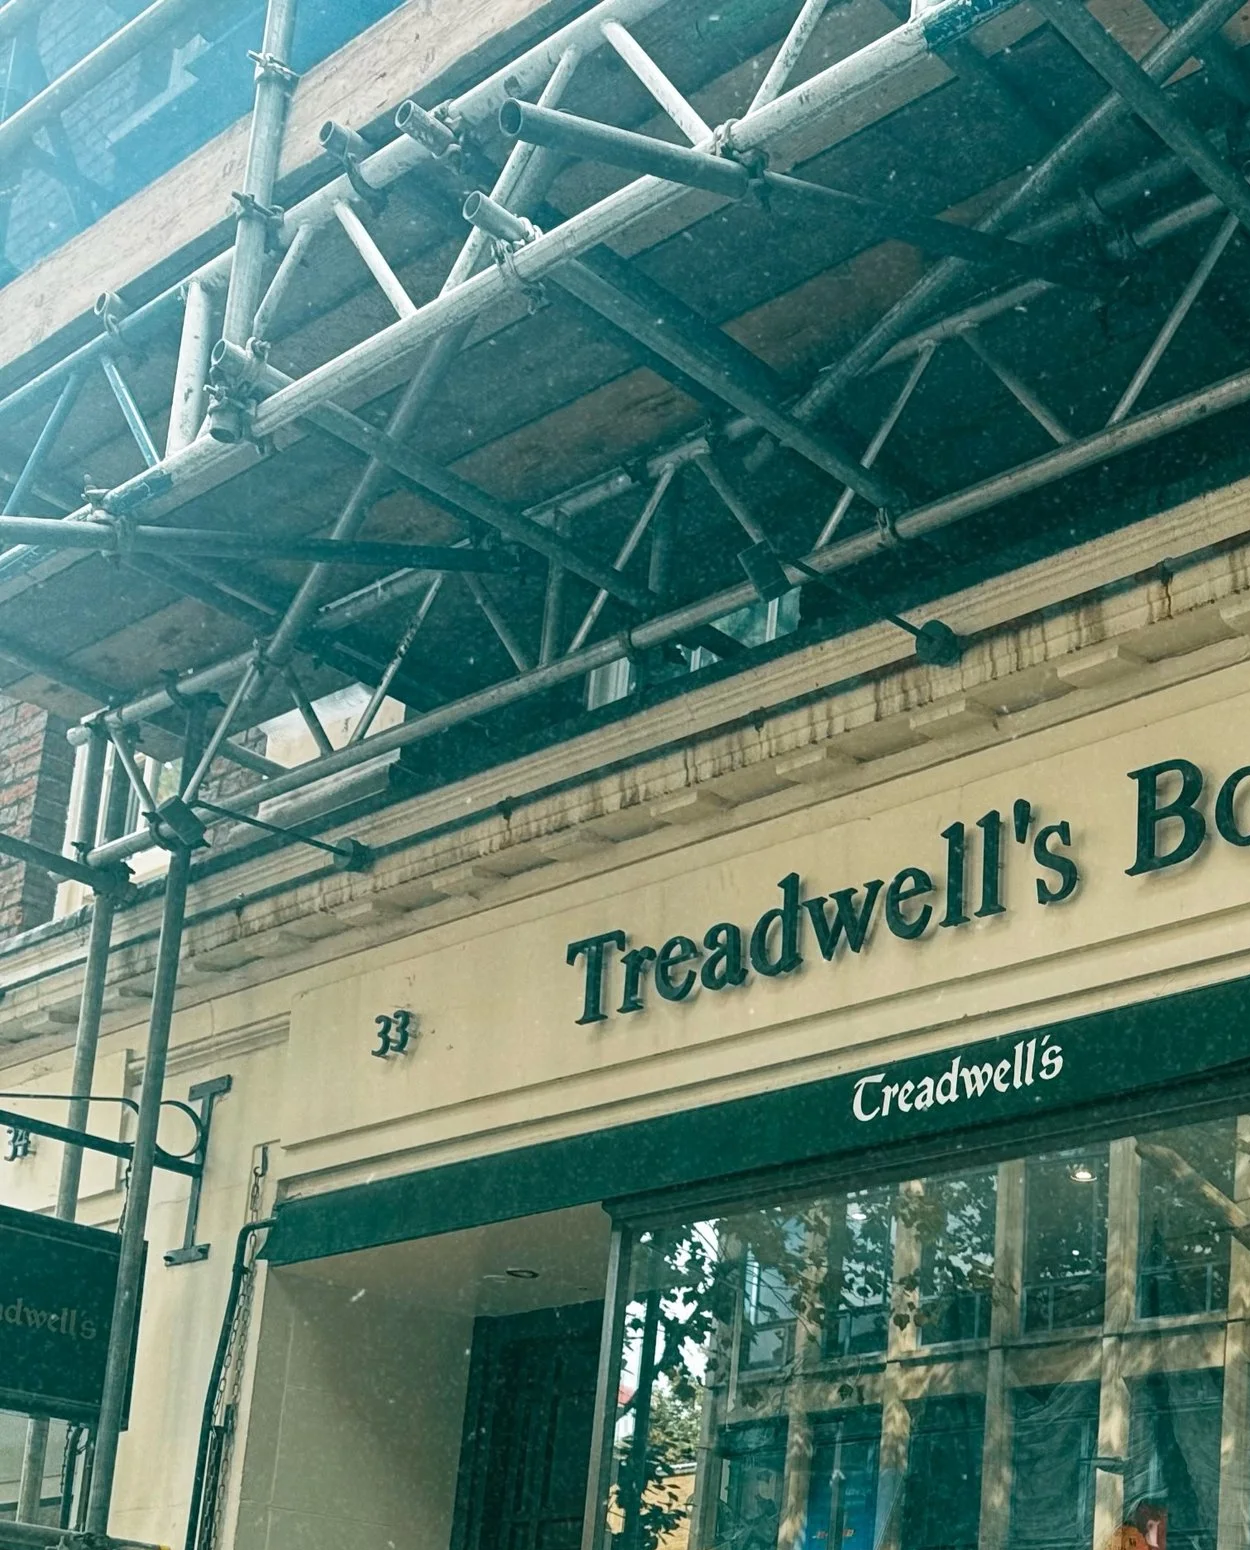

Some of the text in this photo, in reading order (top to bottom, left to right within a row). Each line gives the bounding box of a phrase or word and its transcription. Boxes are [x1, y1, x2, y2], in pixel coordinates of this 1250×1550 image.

[566, 799, 1081, 1026] Treadwell's
[370, 1008, 412, 1059] 33
[852, 1034, 1064, 1123] Treadwell's
[0, 1297, 97, 1340] dwell's
